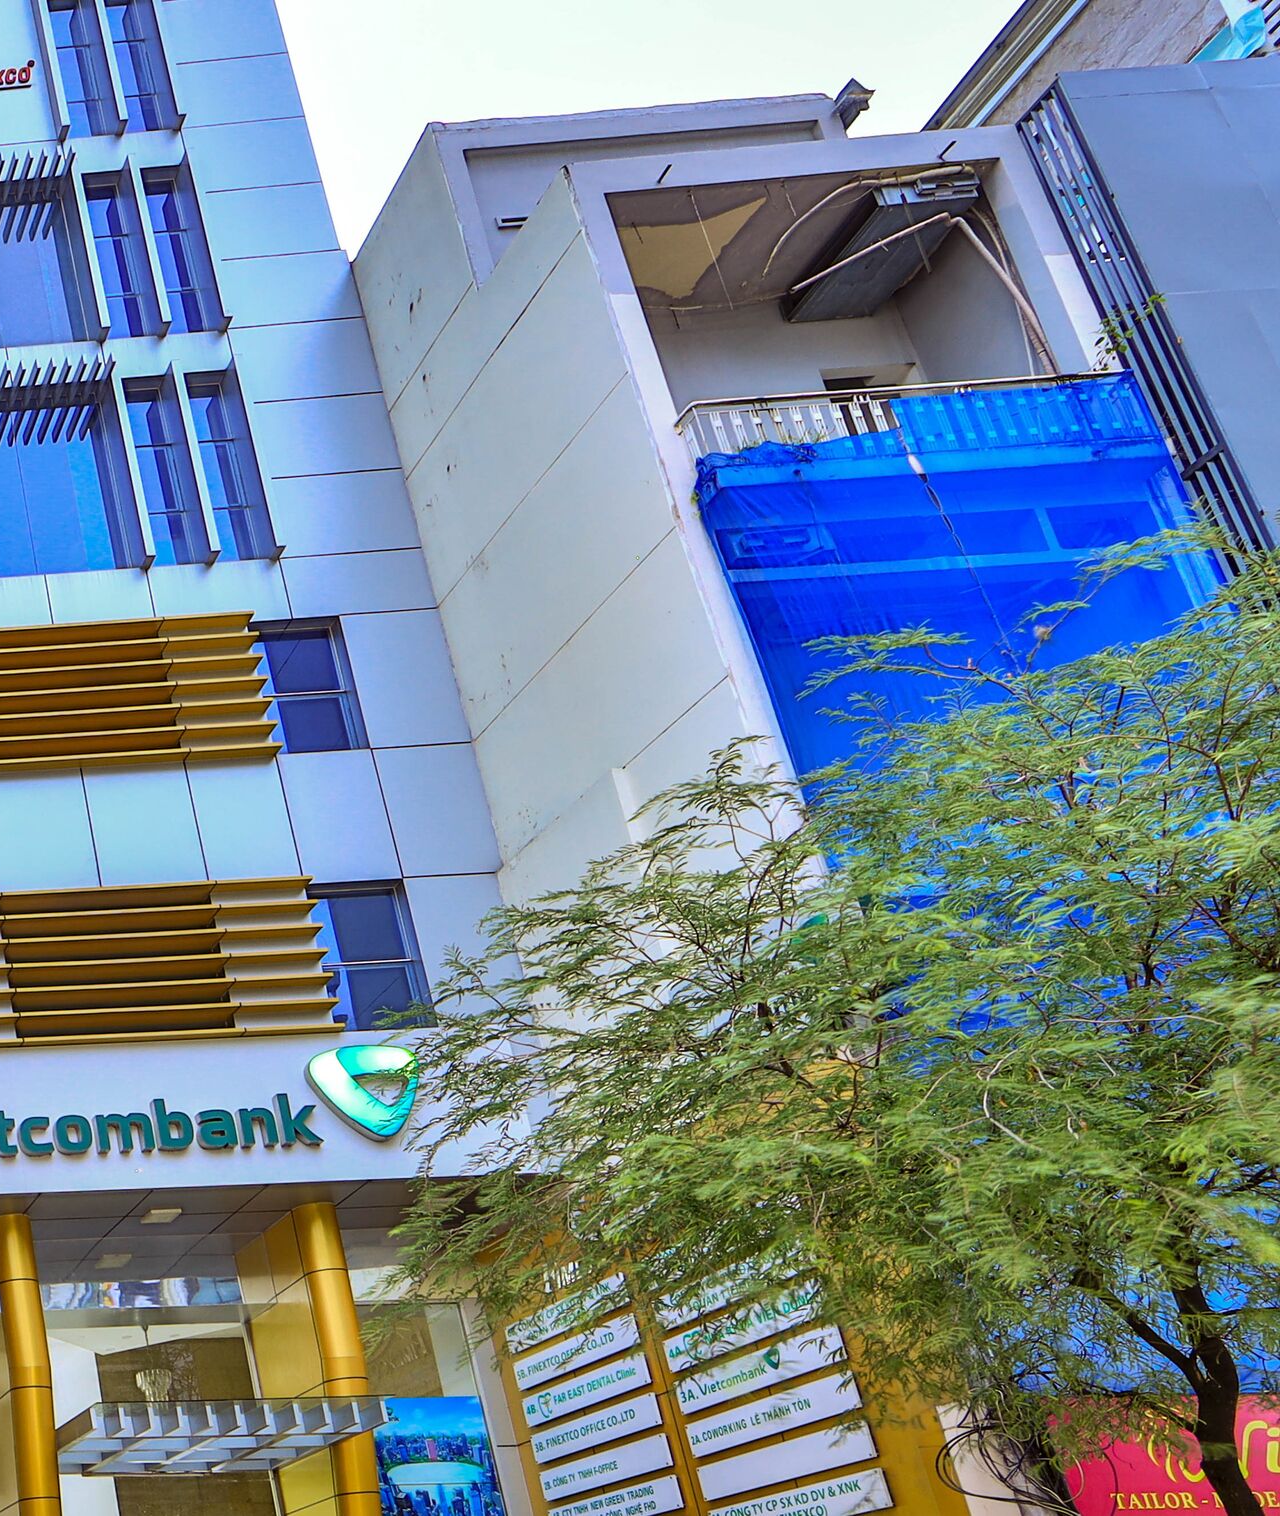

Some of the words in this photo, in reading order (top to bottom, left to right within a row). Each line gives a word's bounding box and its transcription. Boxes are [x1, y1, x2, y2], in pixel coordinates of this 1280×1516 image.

[553, 1392, 568, 1406] FAR
[567, 1384, 586, 1402] EAST
[587, 1374, 617, 1393] DENTAL
[615, 1366, 637, 1381] Clinic
[680, 1389, 699, 1404] 3A.
[700, 1364, 767, 1397] Vietcombank
[546, 1429, 580, 1449] FINEXTCO
[580, 1420, 606, 1438] OFFICE
[702, 1418, 747, 1442] COWORKING
[569, 1472, 577, 1483] TY
[577, 1467, 593, 1480] TNHH
[590, 1500, 604, 1510] NEW
[605, 1493, 625, 1507] GREEN
[627, 1486, 655, 1500] TRADING
[752, 1503, 764, 1515] TY
[766, 1499, 778, 1512] CP
[780, 1496, 793, 1509] SX
[793, 1492, 810, 1506] KD
[811, 1488, 826, 1502] DV
[828, 1486, 837, 1498] &
[836, 1479, 862, 1495] XNK
[1110, 1491, 1198, 1510] TAILOR
[1210, 1491, 1277, 1509] MDE
